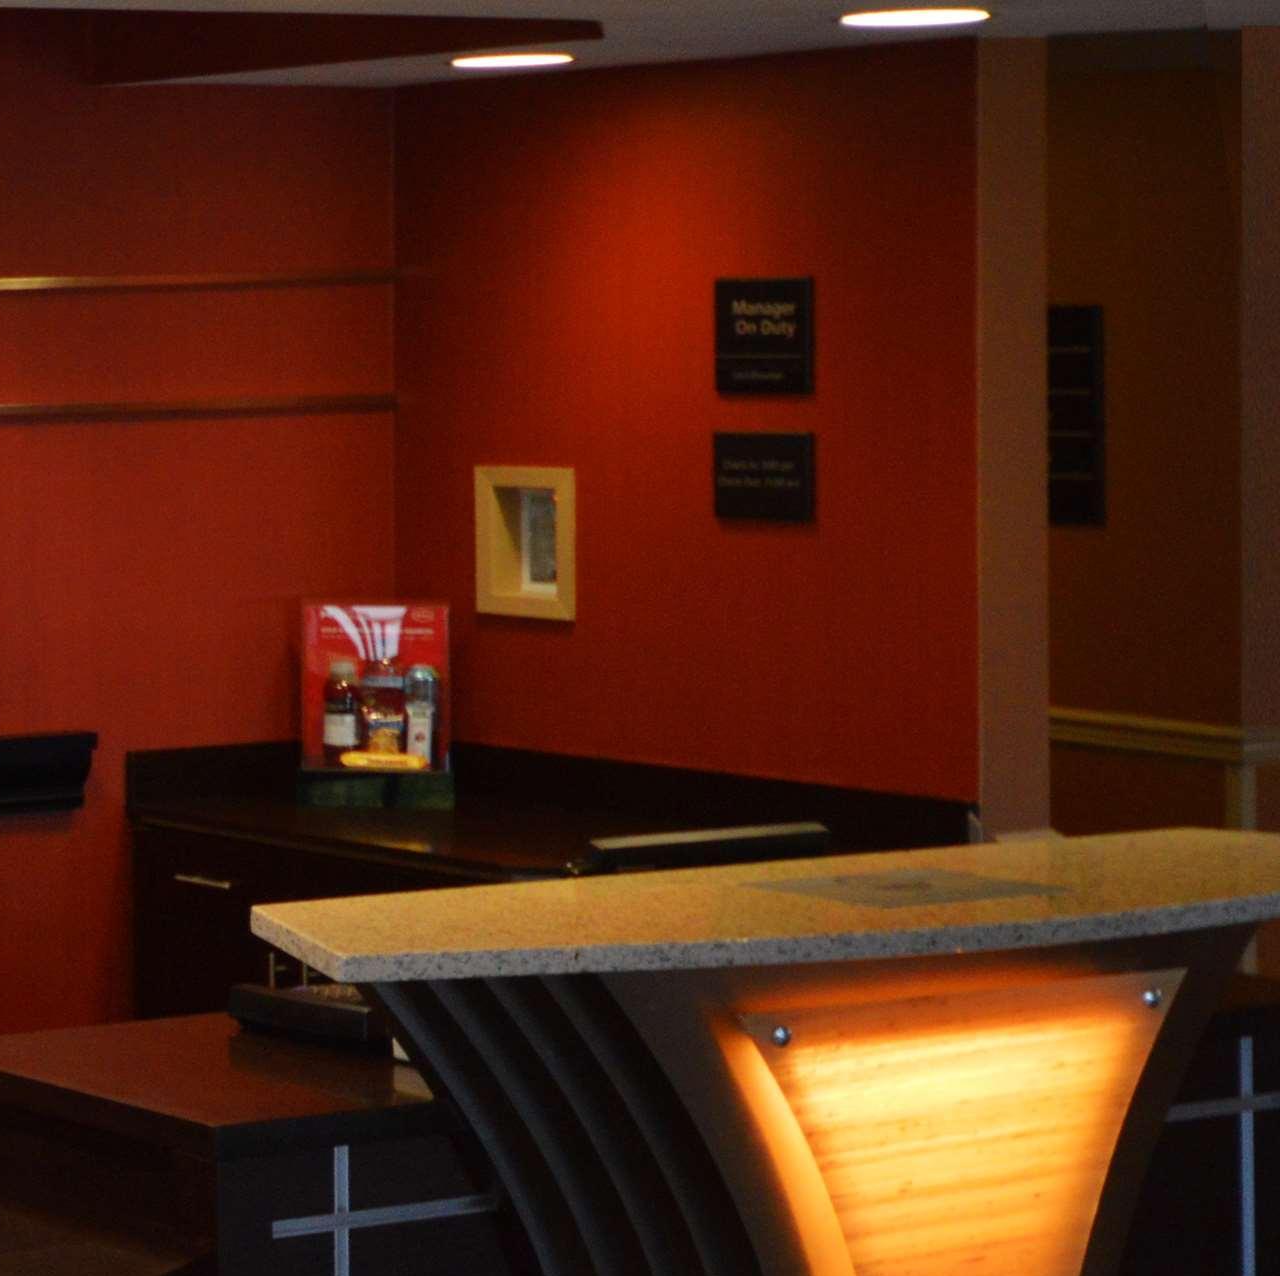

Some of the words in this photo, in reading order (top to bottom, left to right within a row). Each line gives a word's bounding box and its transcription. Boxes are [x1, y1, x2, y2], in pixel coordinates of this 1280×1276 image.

[731, 299, 797, 320] Manager
[734, 319, 757, 336] On
[760, 318, 797, 339] Duty
